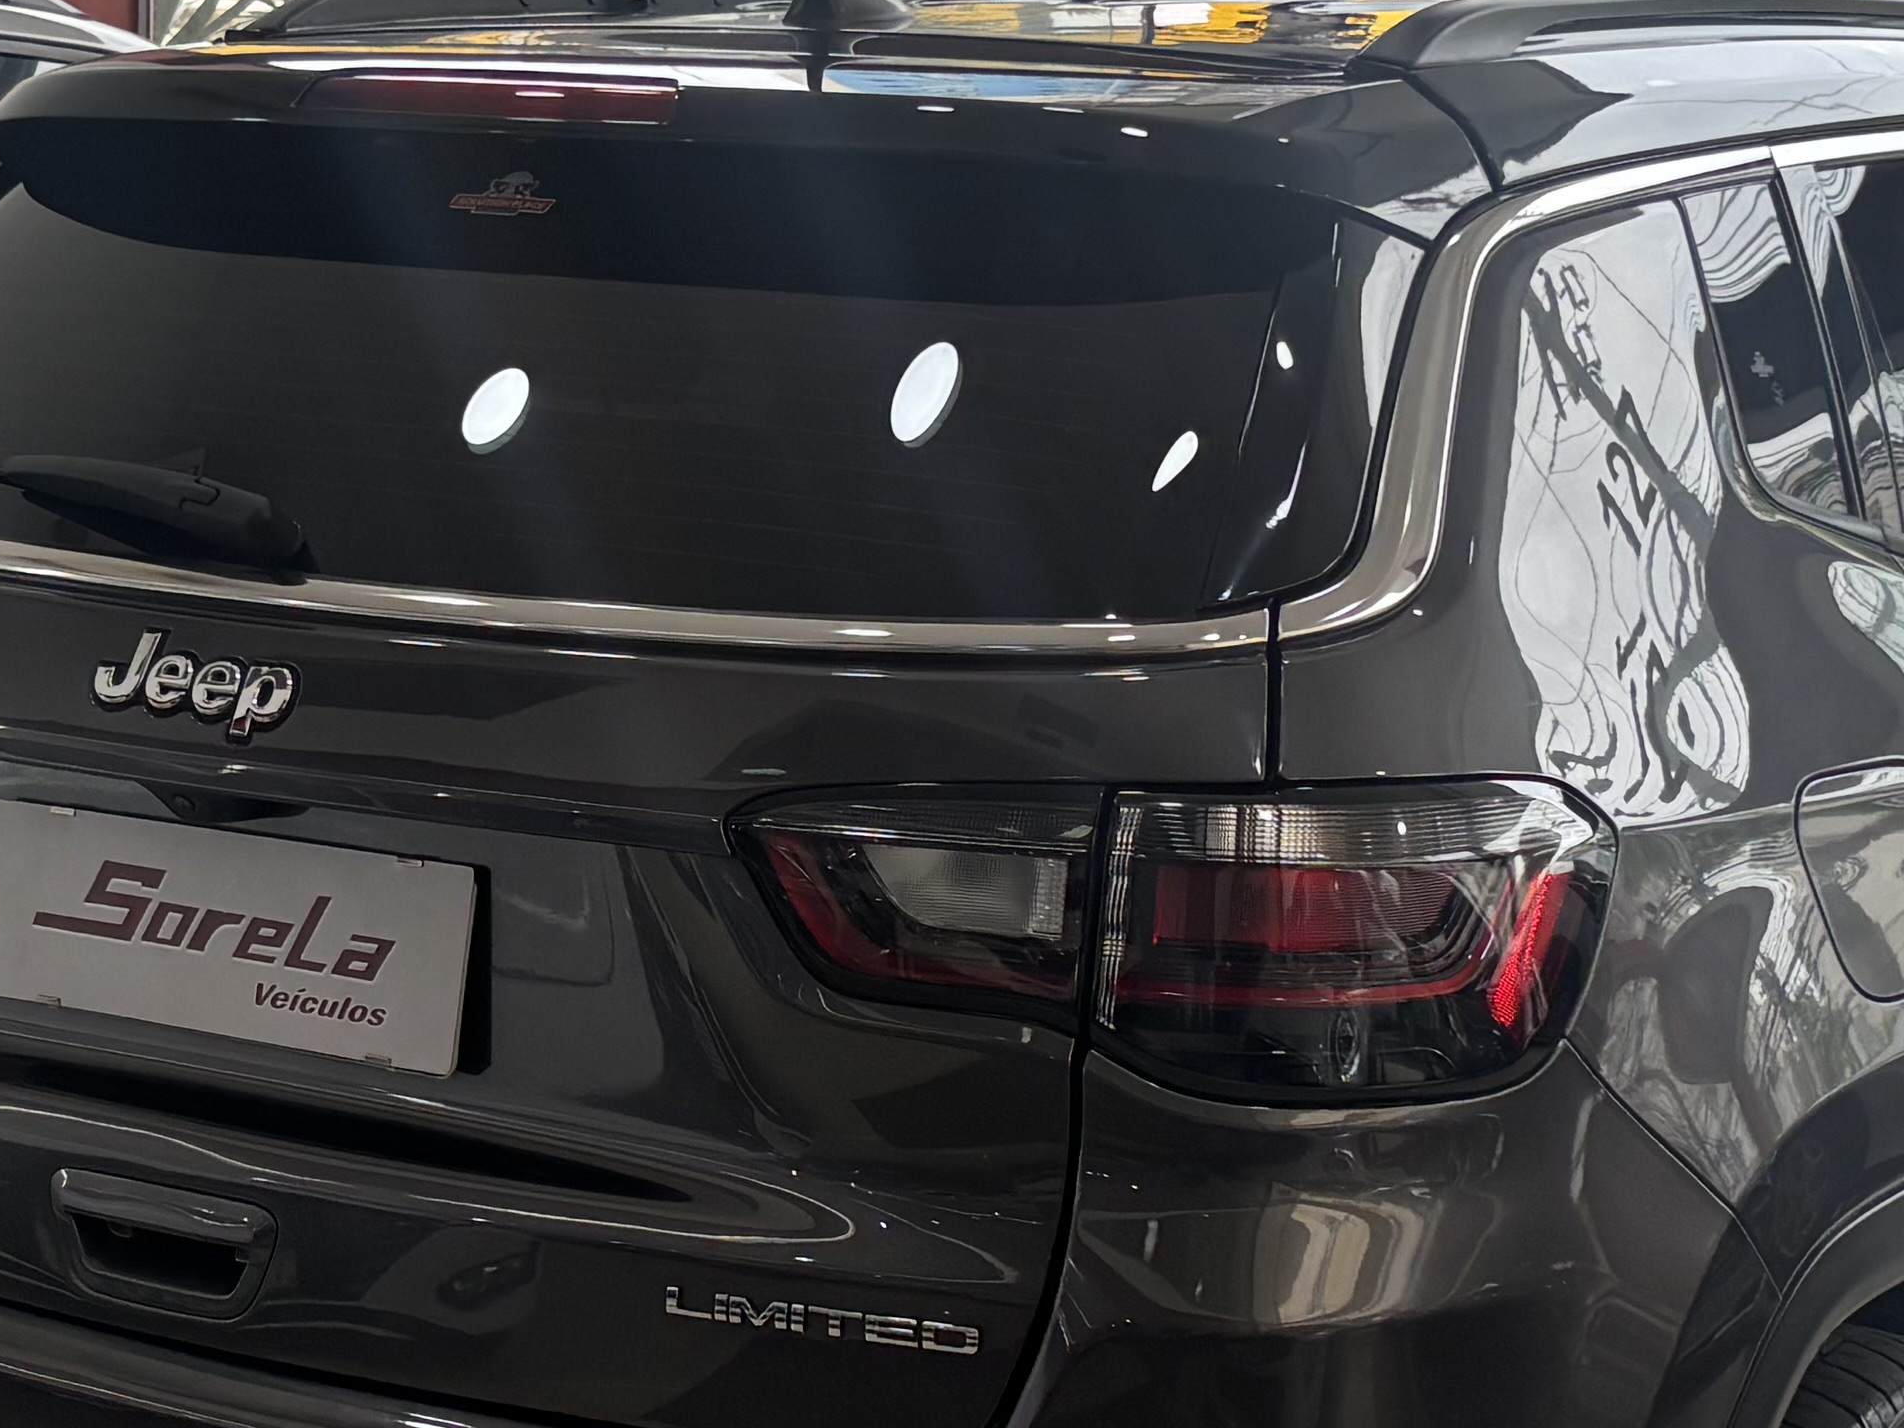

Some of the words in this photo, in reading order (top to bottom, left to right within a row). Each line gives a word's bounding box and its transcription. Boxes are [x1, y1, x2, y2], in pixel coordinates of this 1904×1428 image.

[94, 631, 294, 737] Jeep
[254, 982, 387, 1027] Veículos
[665, 1285, 980, 1356] LIMITED
